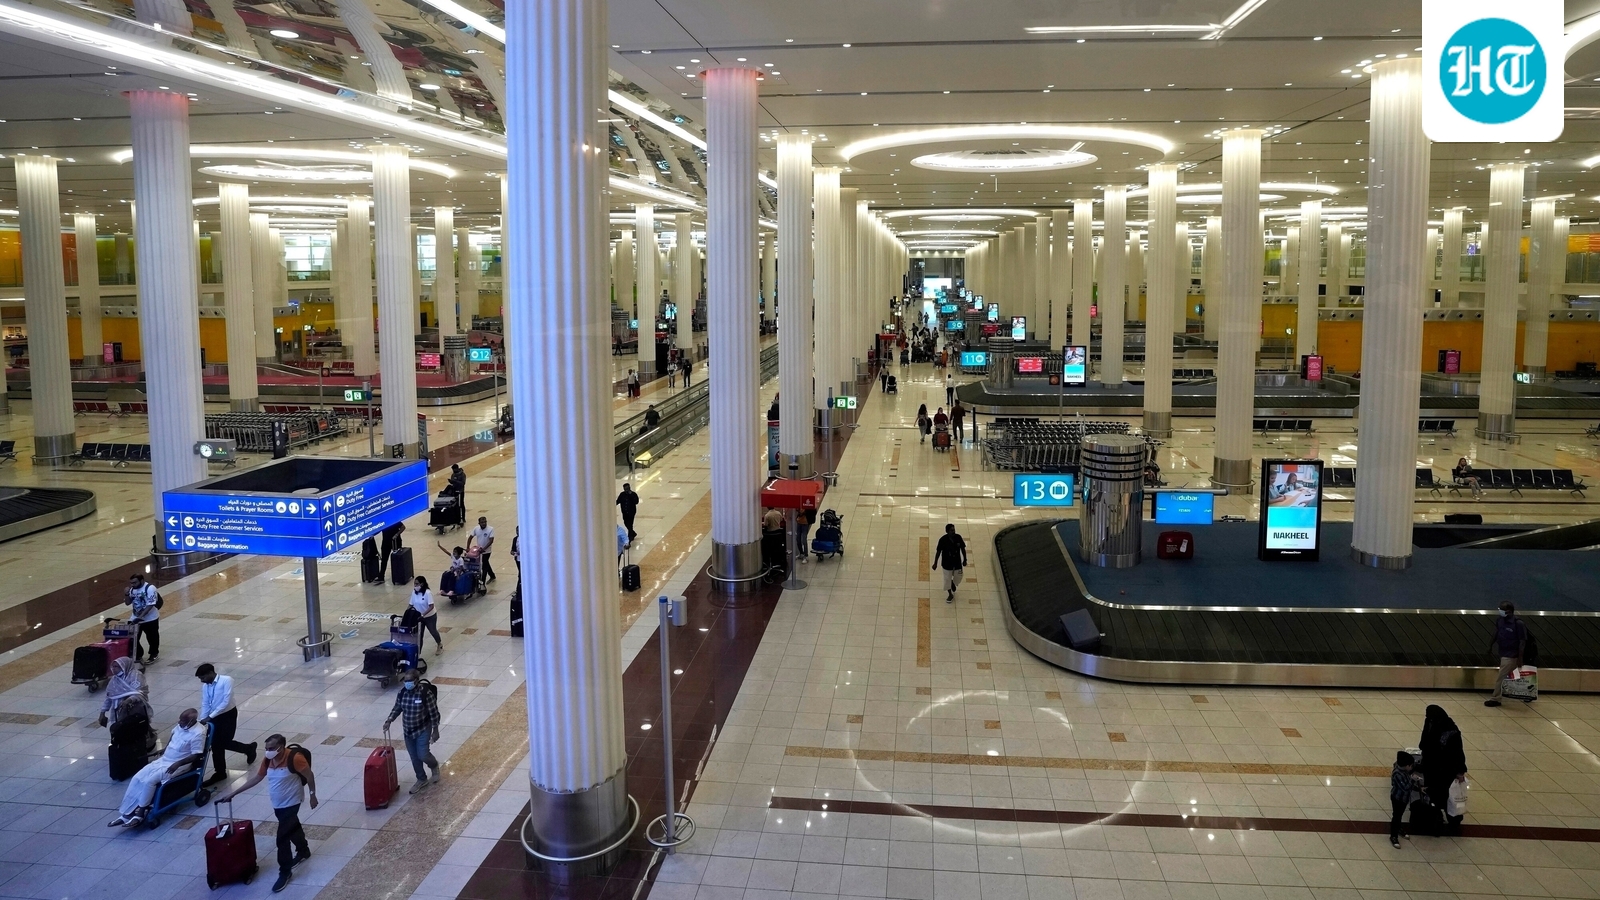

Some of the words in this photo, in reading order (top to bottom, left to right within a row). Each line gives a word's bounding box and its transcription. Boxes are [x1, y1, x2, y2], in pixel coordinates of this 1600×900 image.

[965, 355, 975, 363] 11
[1020, 481, 1045, 500] 13
[365, 506, 382, 515] Customer
[382, 500, 395, 509] Services
[348, 530, 364, 541] Baggage
[365, 522, 385, 533] Information
